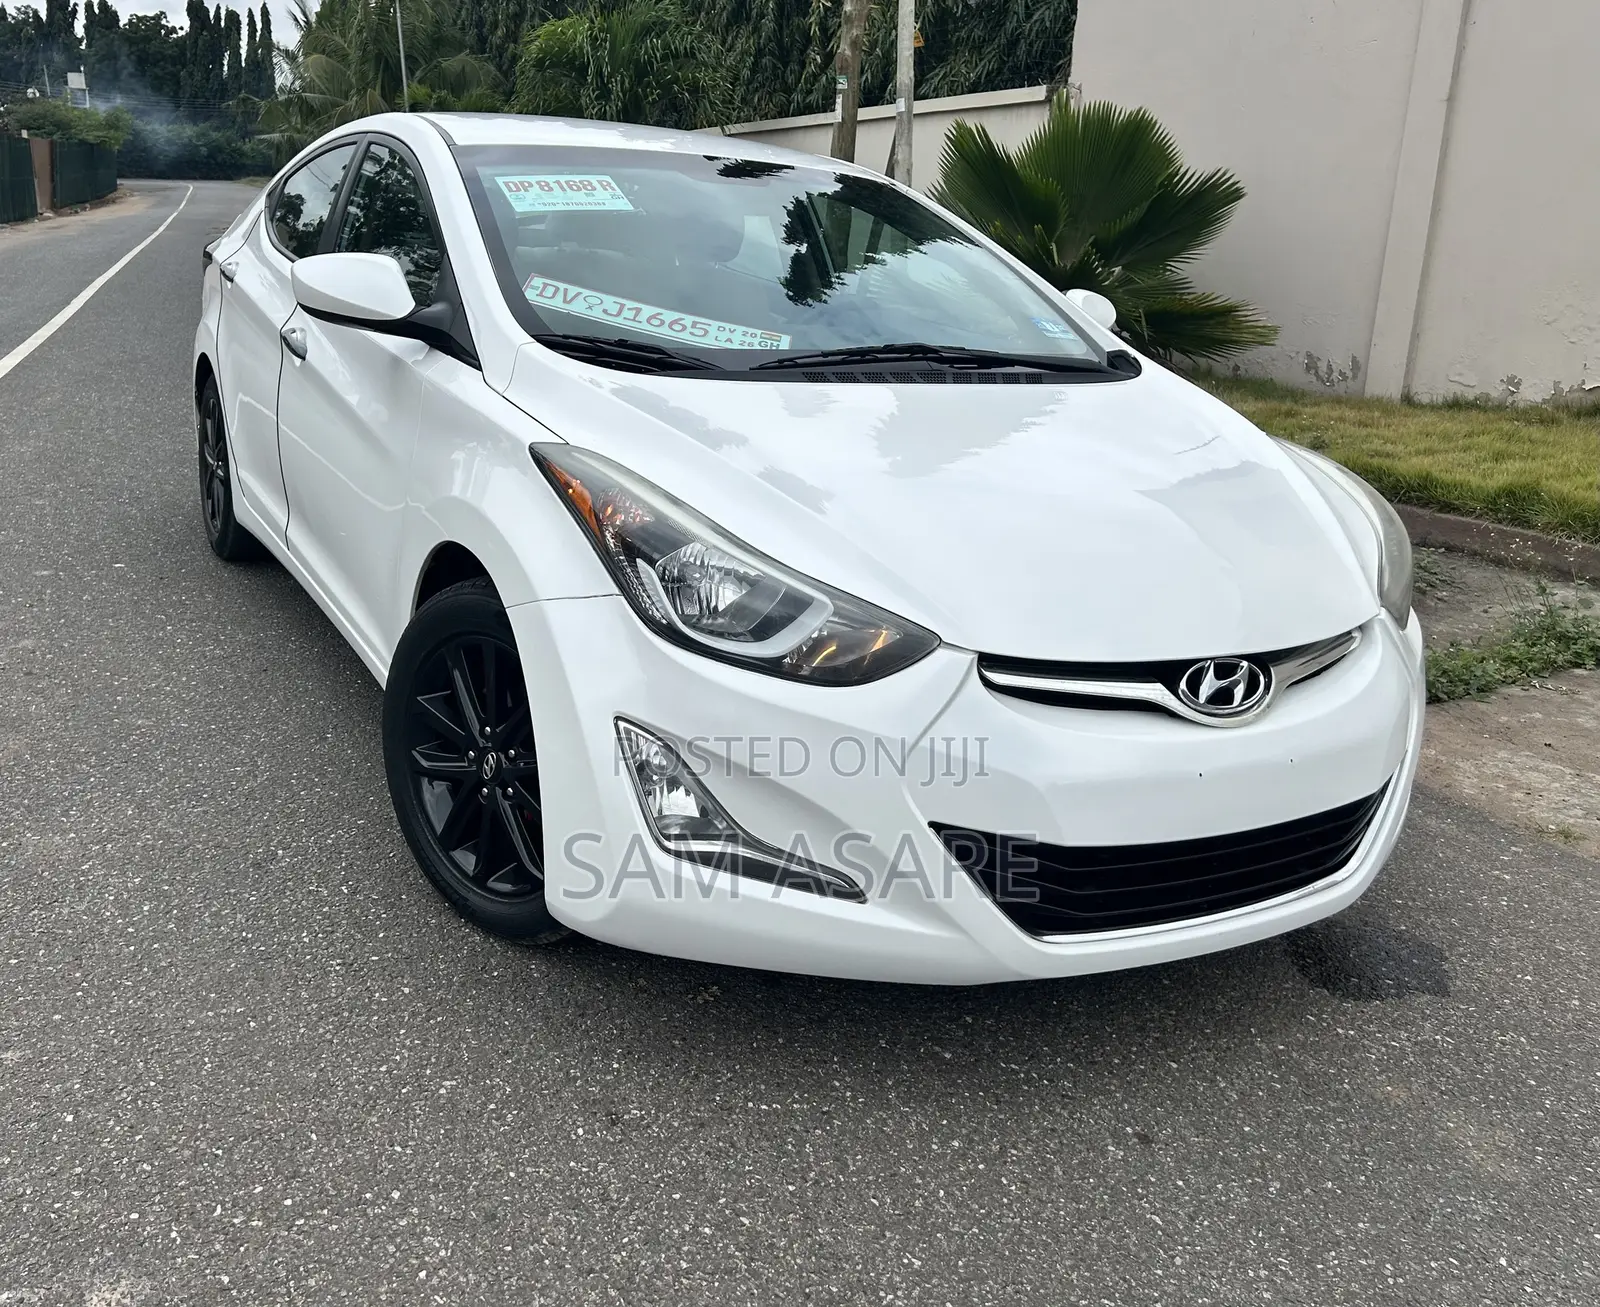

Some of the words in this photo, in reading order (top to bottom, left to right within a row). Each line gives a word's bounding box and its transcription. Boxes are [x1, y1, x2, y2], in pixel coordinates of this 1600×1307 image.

[503, 181, 533, 192] DP
[535, 180, 597, 192] 8168
[596, 180, 617, 192] R
[536, 282, 583, 304] DV
[602, 301, 712, 337] J1665
[741, 330, 758, 338] 20
[714, 335, 734, 344] LA
[758, 340, 780, 349] GH
